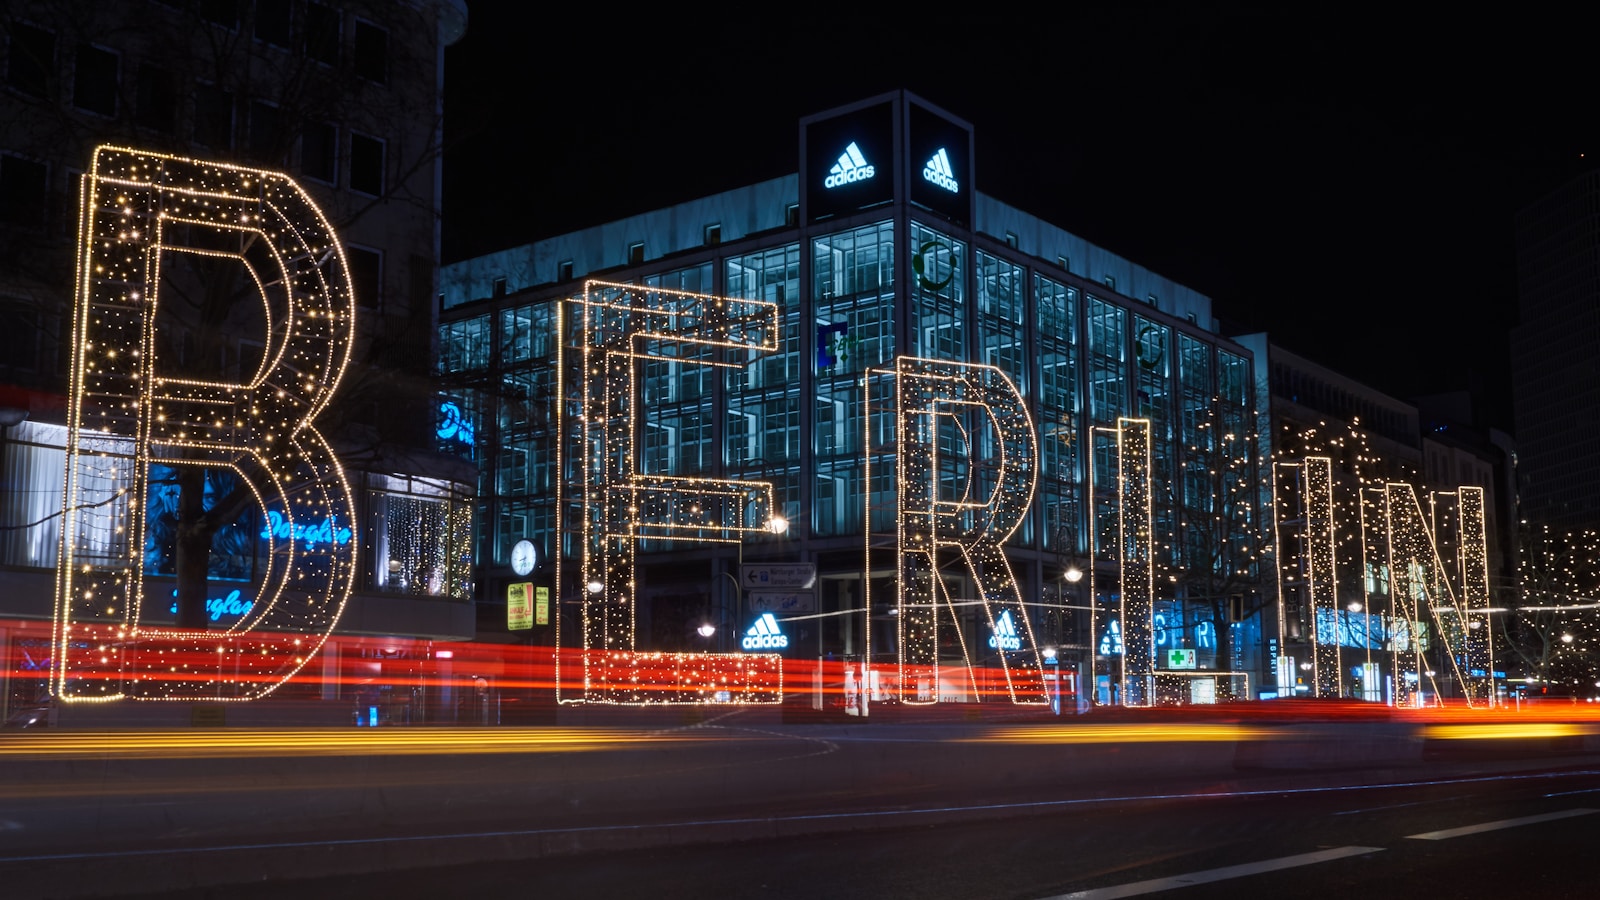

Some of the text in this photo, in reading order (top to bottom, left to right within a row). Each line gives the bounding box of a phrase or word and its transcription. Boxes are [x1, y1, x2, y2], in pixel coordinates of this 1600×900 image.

[824, 165, 875, 188] adidas
[923, 166, 959, 193] adidas
[49, 144, 1495, 708] BERLIN
[742, 634, 788, 649] adidas
